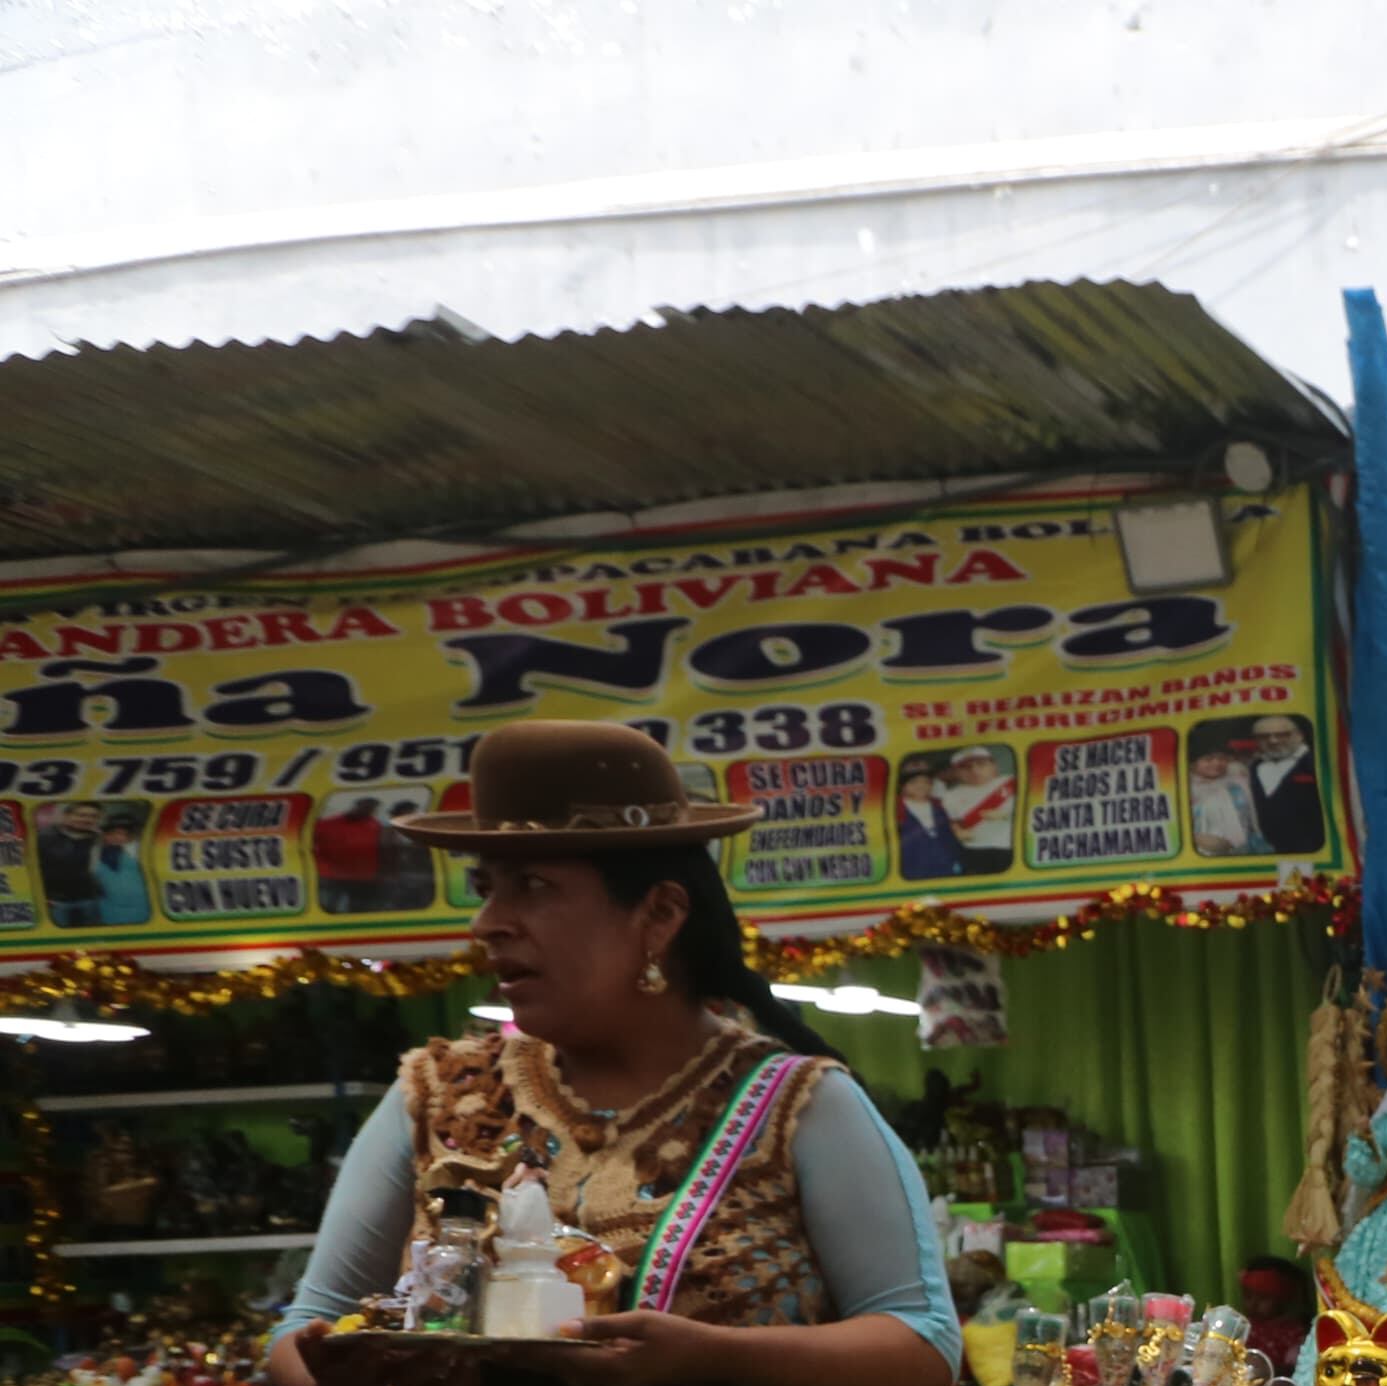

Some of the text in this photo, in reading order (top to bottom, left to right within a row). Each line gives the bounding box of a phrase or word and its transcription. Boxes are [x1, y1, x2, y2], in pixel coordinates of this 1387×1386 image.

[427, 547, 1028, 632] BOLIVIANA
[443, 594, 1236, 711] Nora
[902, 701, 958, 720] SE
[965, 684, 1153, 717] REALIZAN
[914, 686, 1290, 741] DE FLORECIMIENTO
[102, 751, 260, 797] 759
[1058, 736, 1149, 774] SE HACEN
[750, 759, 866, 791] SE CURA
[1047, 764, 1156, 802] PAGOS A LA
[1032, 794, 1171, 833] SANTA TIERRA
[172, 836, 282, 872] EL SUSTO
[1036, 825, 1168, 862] PACHAMAMA
